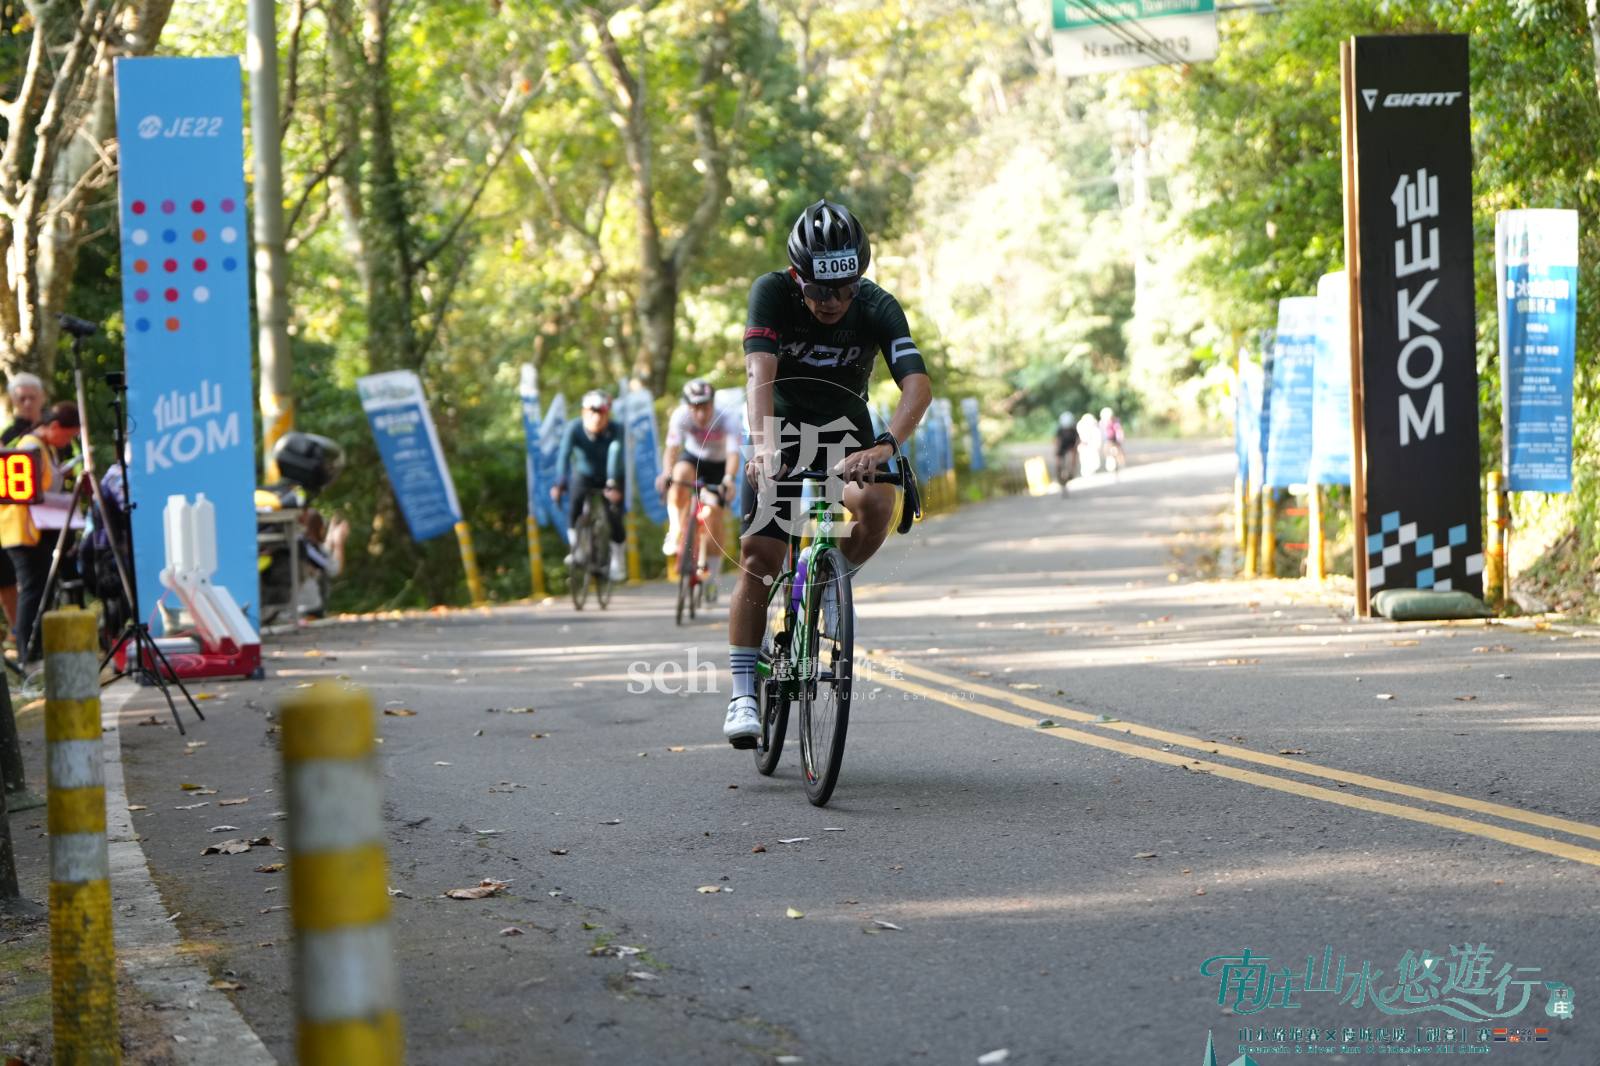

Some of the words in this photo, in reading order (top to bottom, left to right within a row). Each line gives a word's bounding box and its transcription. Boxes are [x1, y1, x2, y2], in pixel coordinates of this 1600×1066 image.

[1382, 91, 1462, 108] GIANT
[163, 116, 224, 138] JE22
[153, 380, 222, 432] 仙山
[145, 411, 240, 475] KOM
